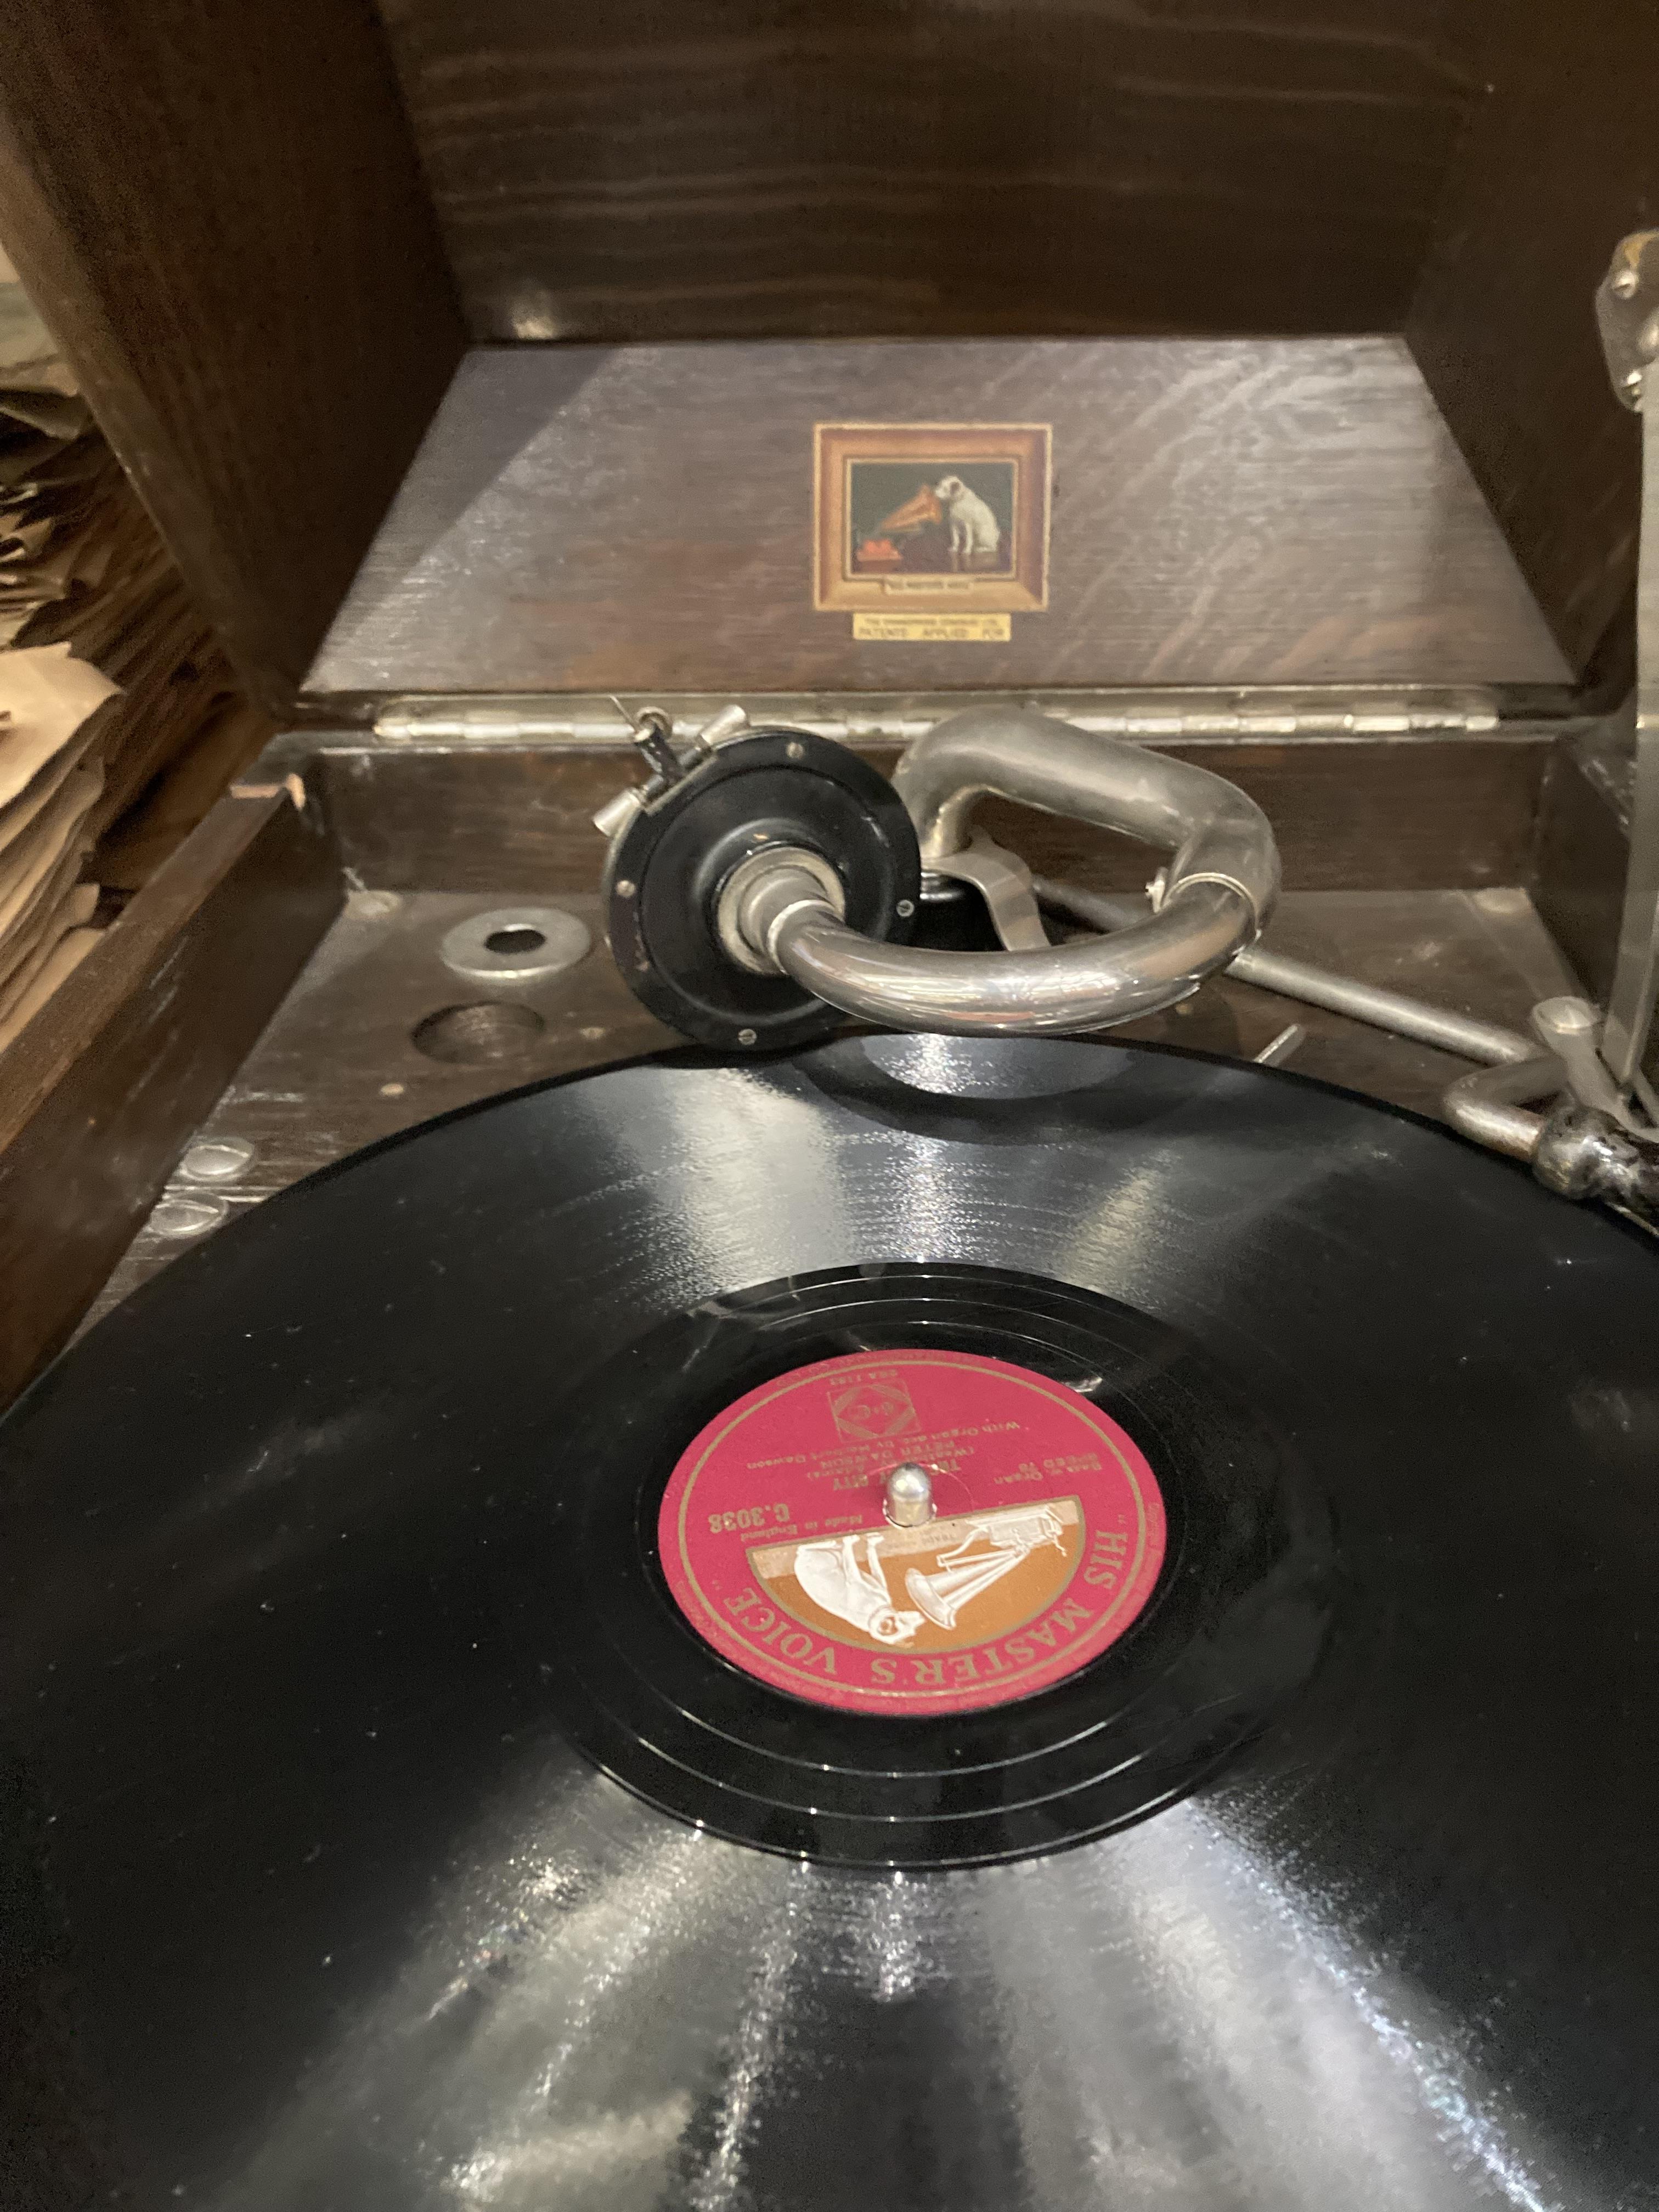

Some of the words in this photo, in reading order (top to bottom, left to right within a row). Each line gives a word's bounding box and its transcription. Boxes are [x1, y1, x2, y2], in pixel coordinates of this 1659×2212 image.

[932, 1426, 978, 1441] Organ
[900, 1440, 954, 1454] PETER
[746, 1455, 805, 1470] Dawson
[820, 1451, 892, 1467] DAWSON
[708, 1503, 789, 1532] C.3038
[825, 1514, 862, 1528] Made
[740, 1524, 798, 1542] England
[804, 1521, 817, 1531] in
[870, 1599, 1090, 1686] MASTER'S
